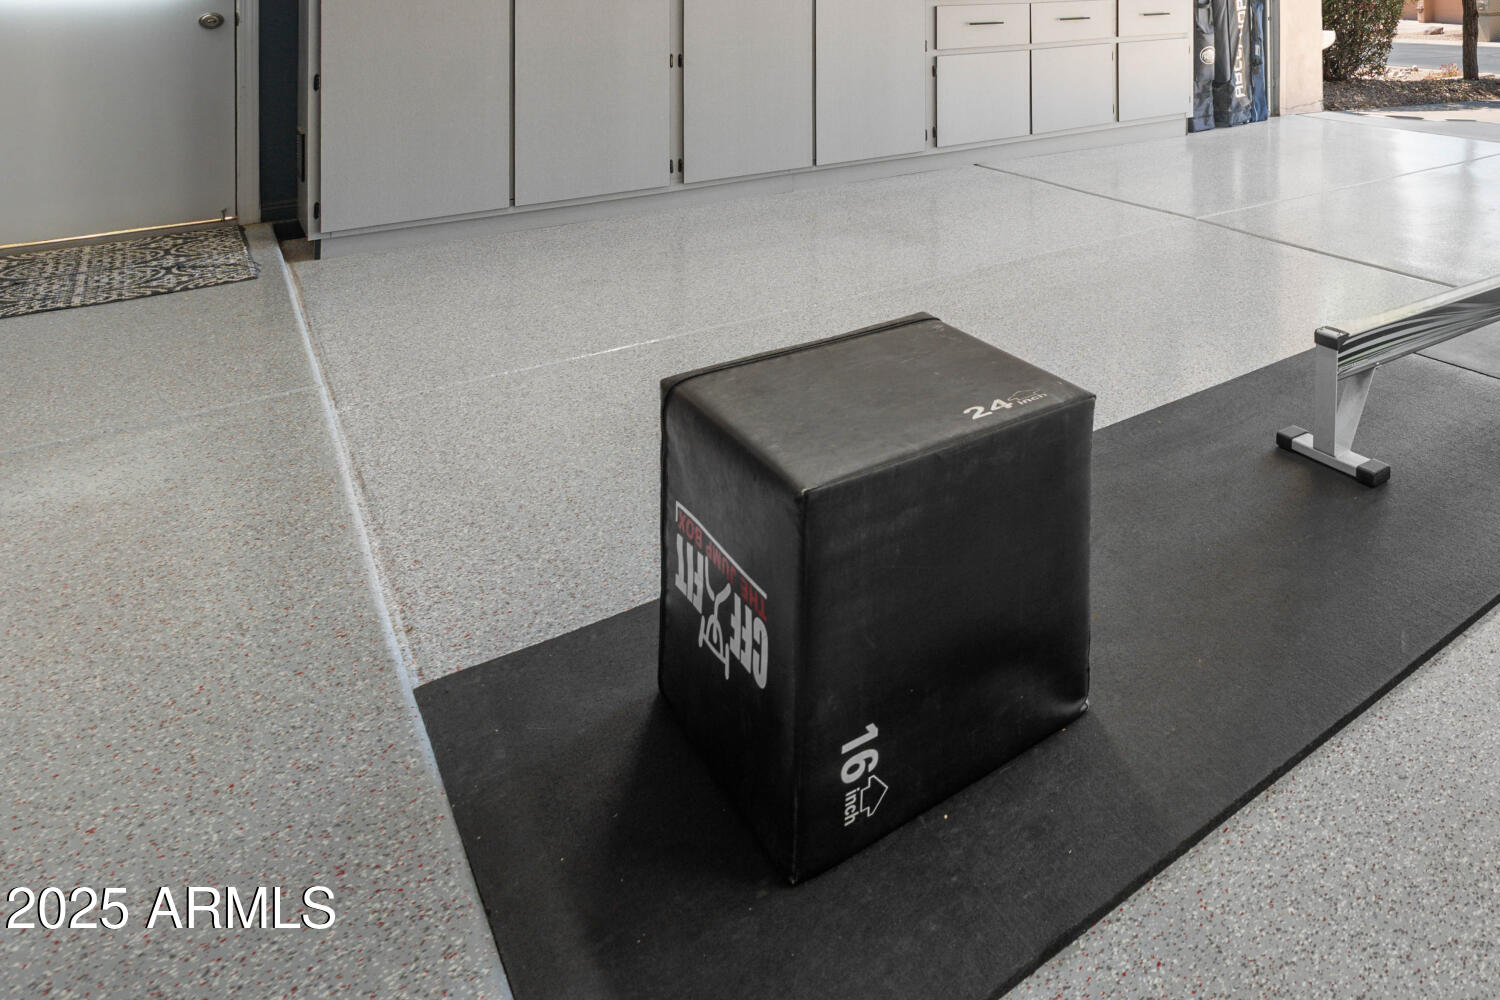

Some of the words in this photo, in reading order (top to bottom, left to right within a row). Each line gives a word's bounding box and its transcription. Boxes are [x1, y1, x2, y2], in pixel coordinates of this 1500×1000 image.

[963, 398, 1014, 420] 24
[1017, 393, 1048, 406] inch
[677, 511, 703, 548] BOX
[675, 533, 704, 615] FIT
[705, 541, 737, 587] JUMP
[740, 577, 768, 623] THE
[840, 722, 879, 784] 16
[844, 787, 860, 827] inch
